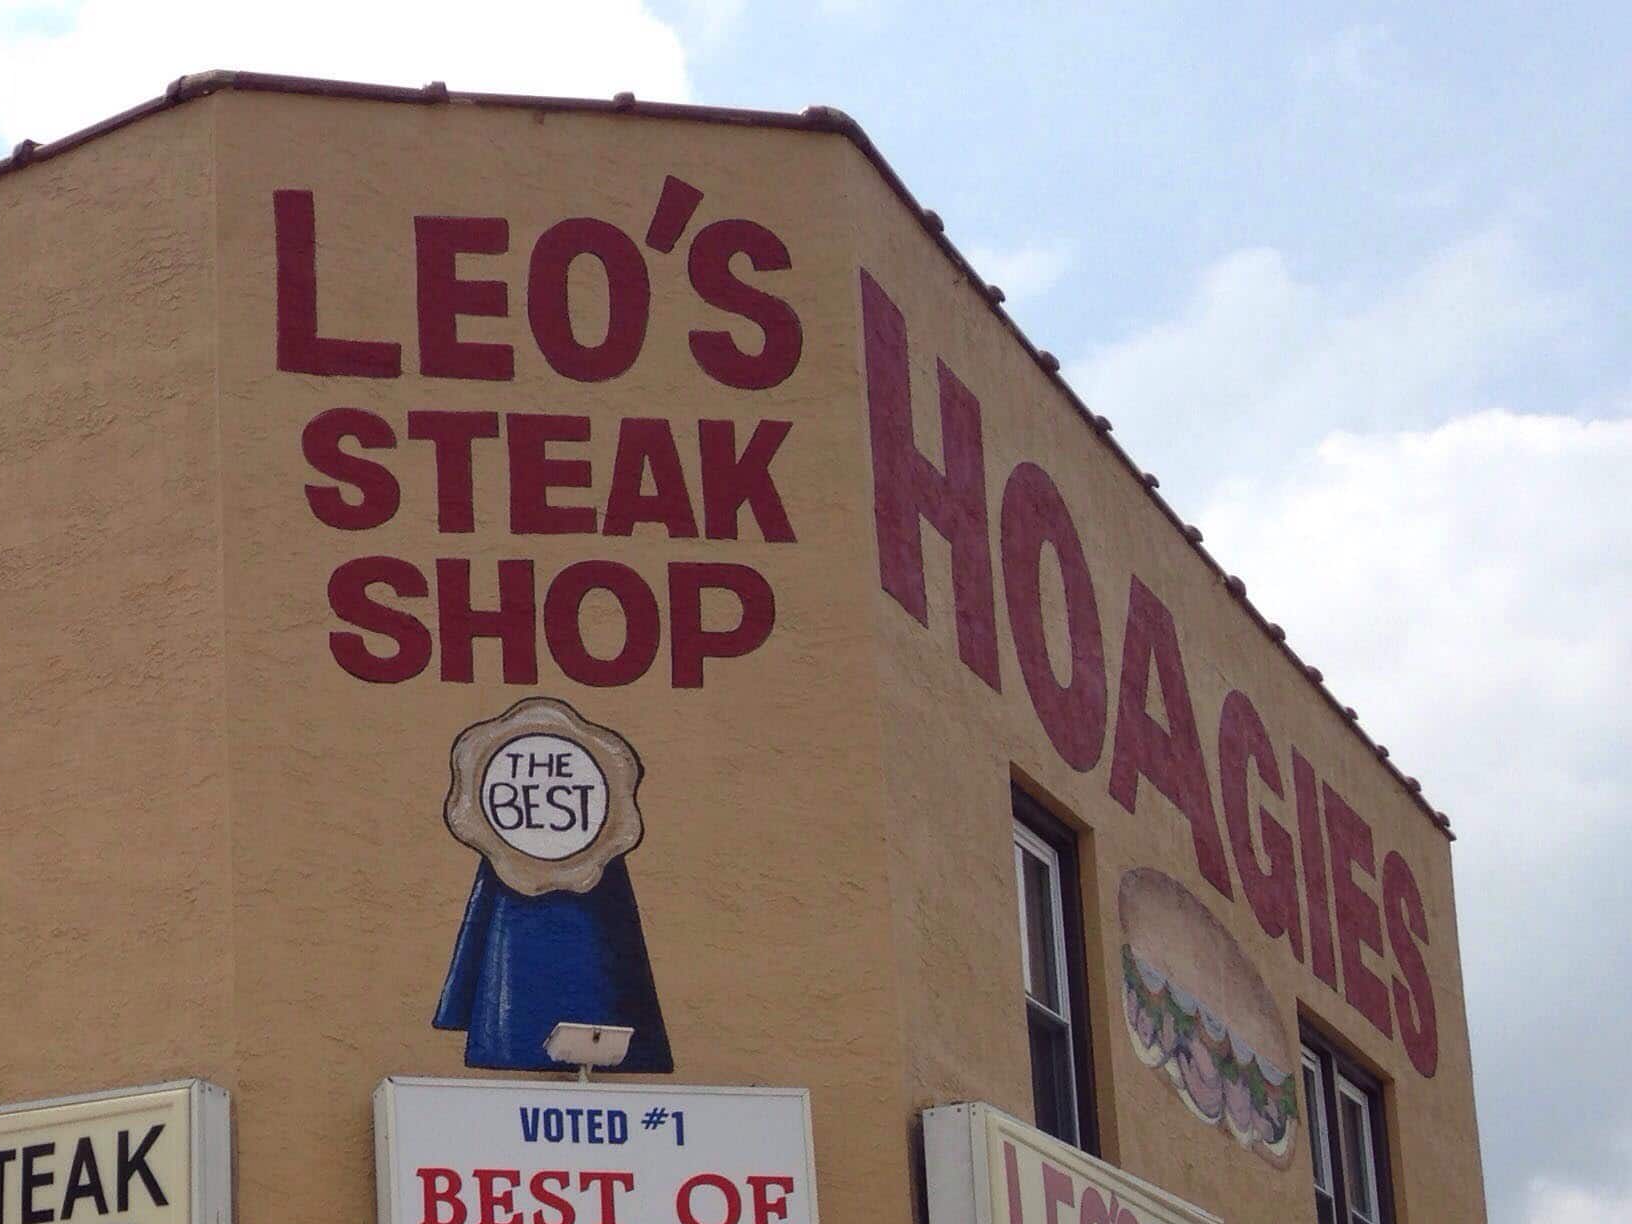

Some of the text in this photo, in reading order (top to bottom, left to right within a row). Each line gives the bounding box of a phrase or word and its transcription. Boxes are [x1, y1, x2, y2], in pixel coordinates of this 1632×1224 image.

[273, 174, 804, 391] LEO'S
[301, 407, 798, 543] STEAK
[327, 556, 776, 688] SHOP
[860, 267, 1439, 1079] HOAGIES
[488, 782, 595, 832] BEST
[505, 752, 574, 779] THE
[519, 1107, 686, 1146] VOTED #1
